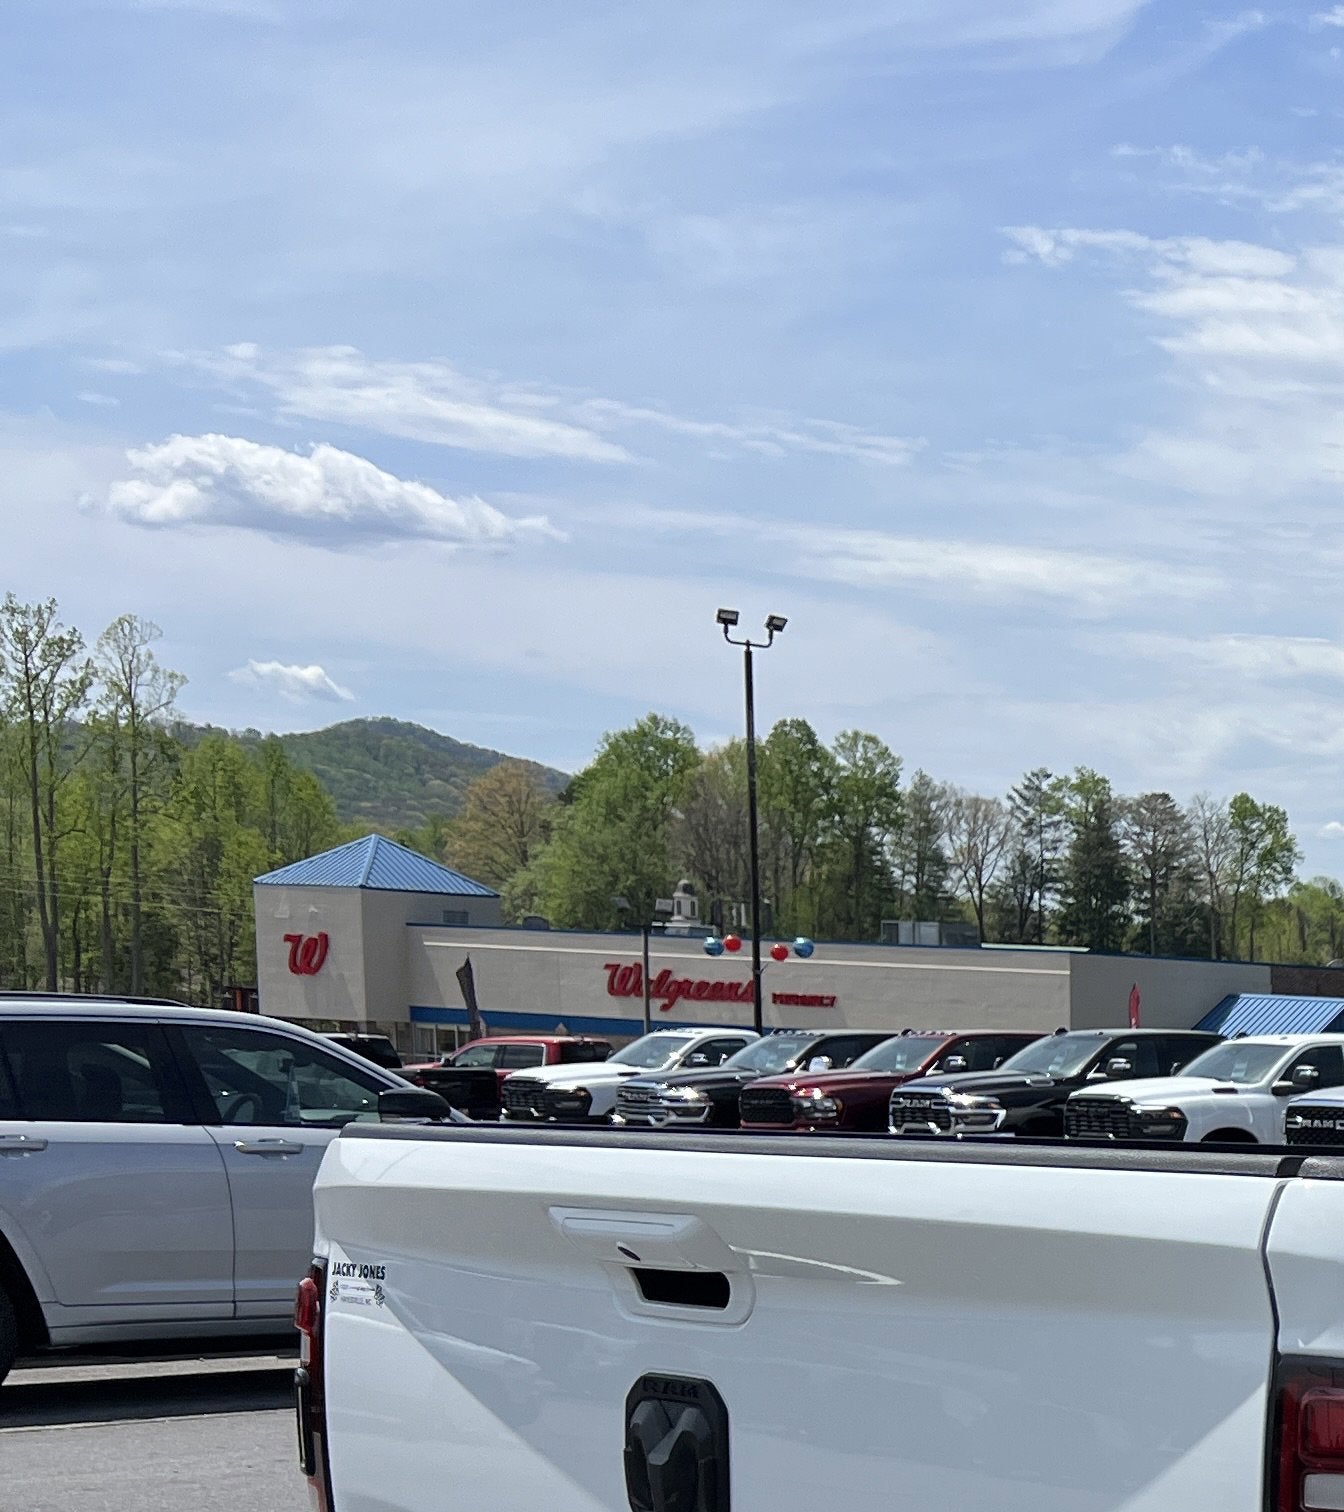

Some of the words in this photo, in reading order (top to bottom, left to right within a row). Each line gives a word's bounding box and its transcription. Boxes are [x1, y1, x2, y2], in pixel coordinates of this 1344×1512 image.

[284, 931, 329, 976] W
[331, 1261, 357, 1278] JACKY
[358, 1263, 386, 1280] JONES
